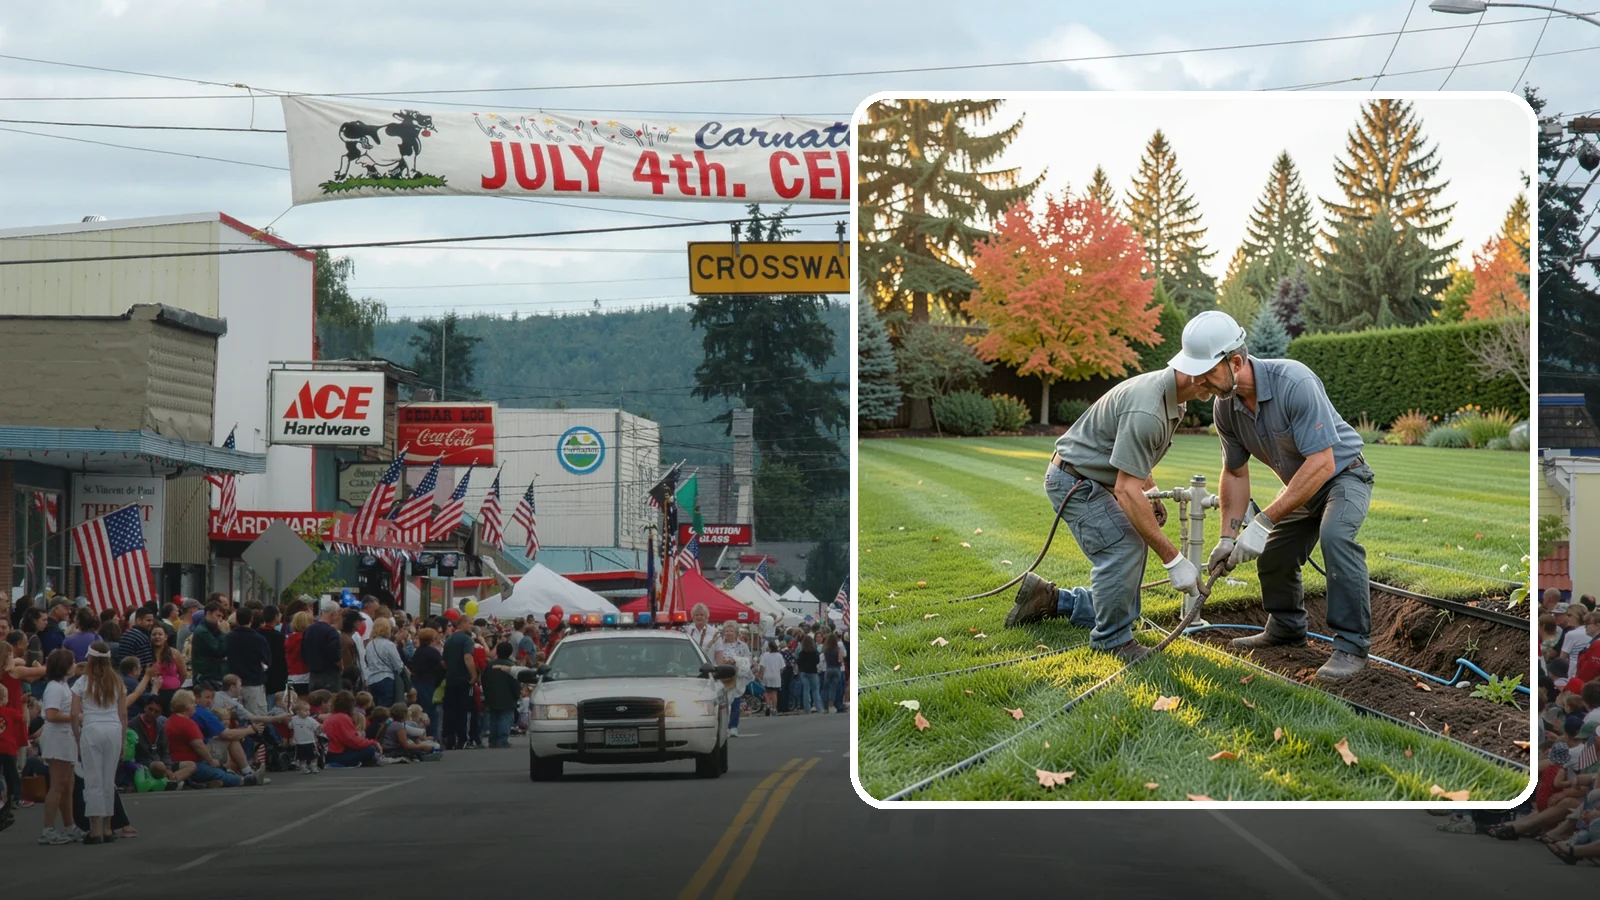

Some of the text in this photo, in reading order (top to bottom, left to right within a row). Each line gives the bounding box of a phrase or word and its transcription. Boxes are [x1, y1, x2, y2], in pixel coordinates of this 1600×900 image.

[481, 141, 605, 192] JULY
[632, 150, 746, 197] 4th.
[697, 254, 850, 280] CROSSWA
[282, 380, 373, 420] ACE
[405, 409, 485, 423] CEDAR LOG
[283, 421, 371, 437] Hardware
[416, 428, 477, 447] Coca-Cola
[95, 484, 124, 495] Vincent
[126, 486, 136, 495] de
[138, 485, 155, 495] Paul
[212, 516, 331, 537] HARDARE
[688, 526, 741, 535] CRNATION
[699, 535, 730, 543] GLASS
